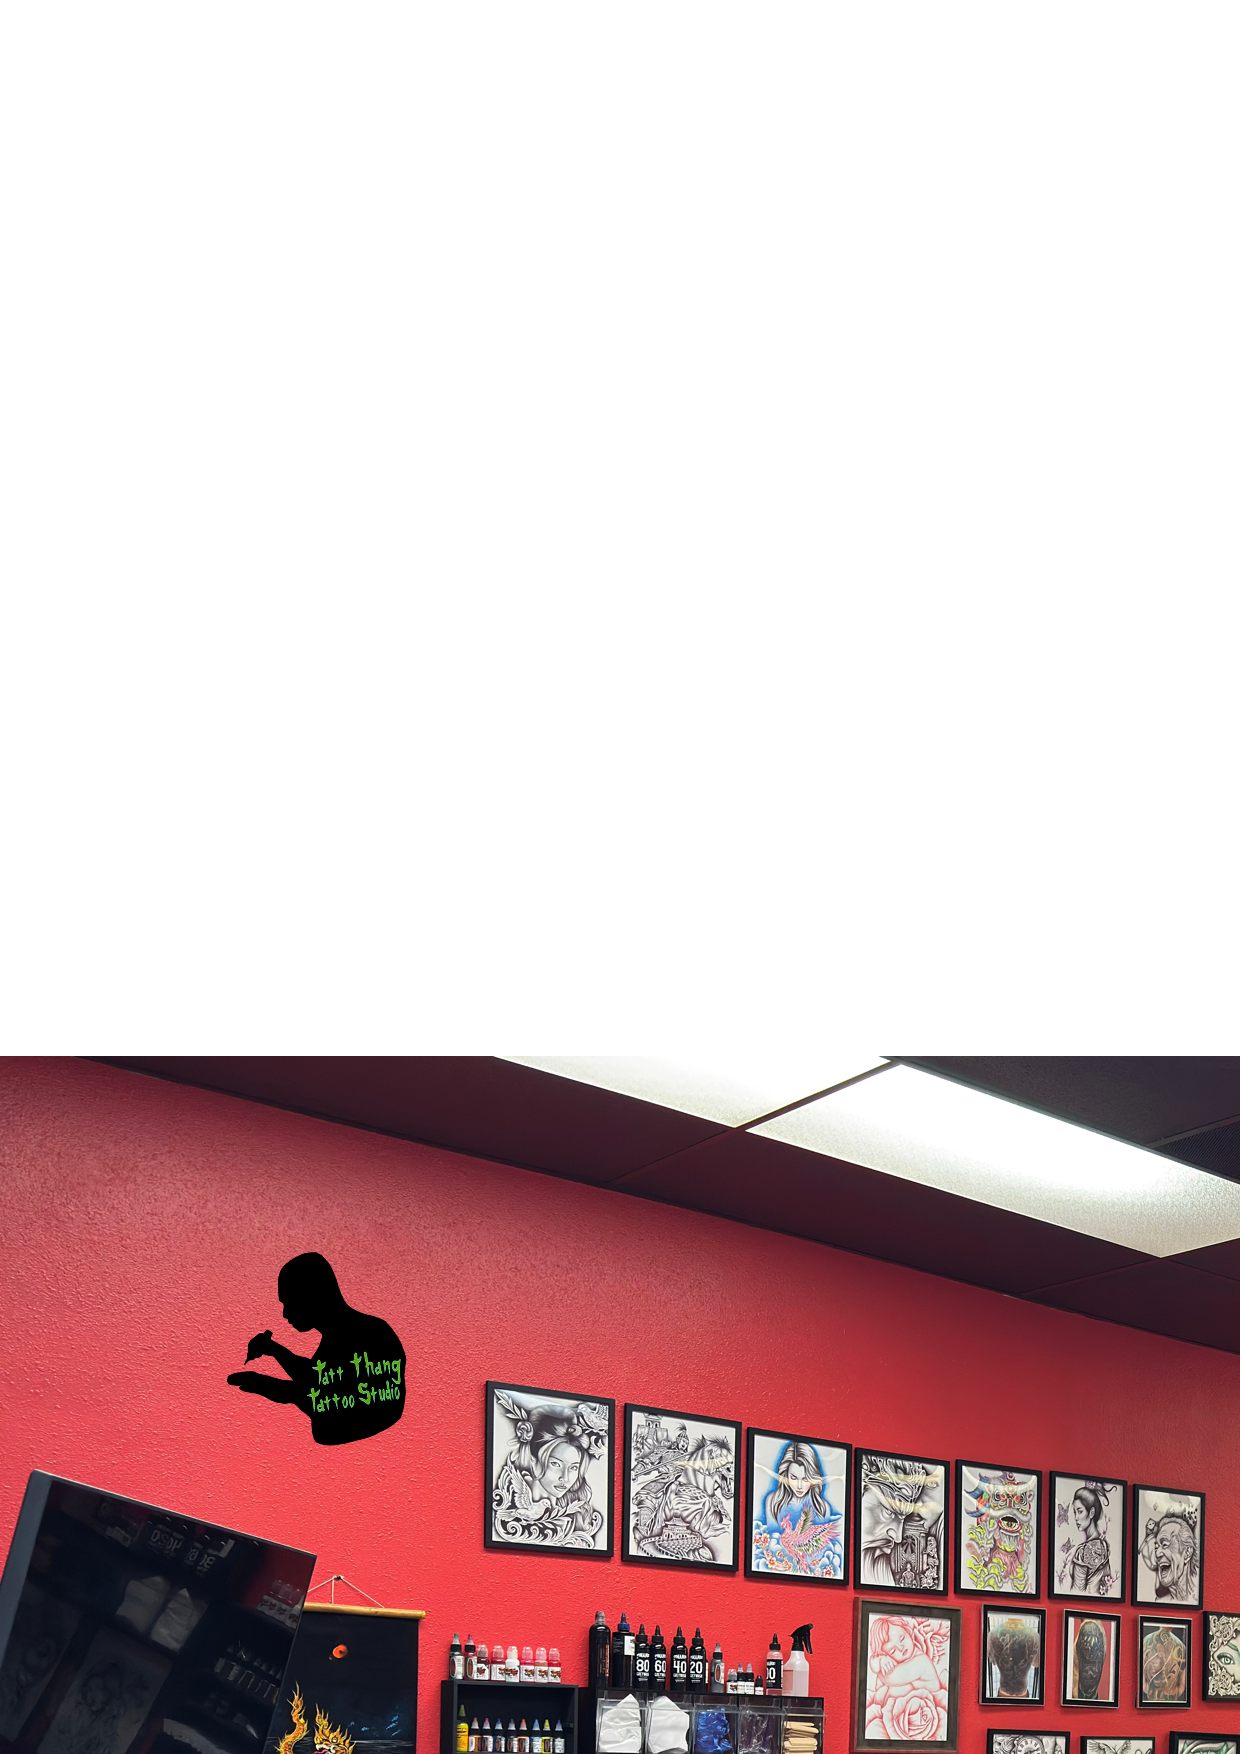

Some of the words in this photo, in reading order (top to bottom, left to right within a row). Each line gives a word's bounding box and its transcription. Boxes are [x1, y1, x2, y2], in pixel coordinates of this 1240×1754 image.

[636, 1659, 650, 1672] 80
[654, 1660, 667, 1673] 60
[673, 1660, 687, 1674] 40
[689, 1661, 703, 1674] 20
